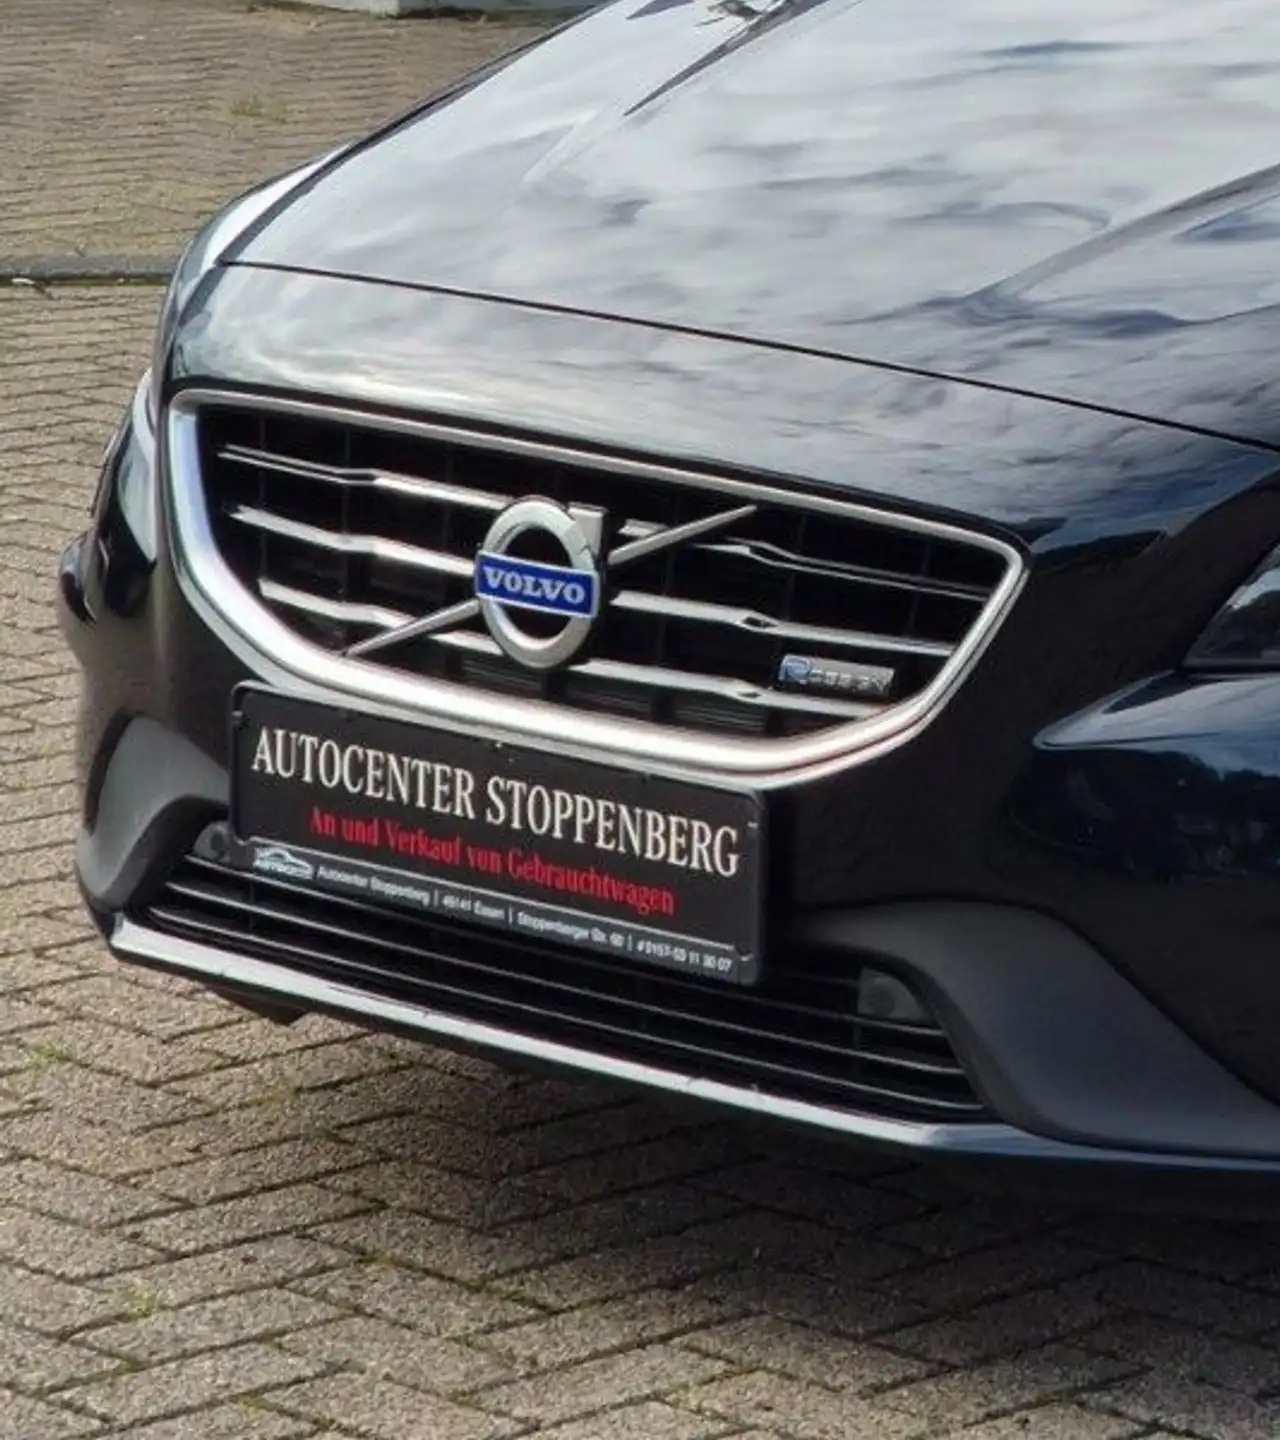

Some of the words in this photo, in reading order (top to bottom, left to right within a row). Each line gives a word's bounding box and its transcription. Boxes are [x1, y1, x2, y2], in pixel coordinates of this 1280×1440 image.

[482, 565, 586, 605] VOLVO
[250, 725, 476, 820] AUTOCENTER
[485, 776, 739, 878] STOPPENBERG
[309, 805, 337, 837] An
[340, 811, 380, 848] und
[385, 816, 462, 864] Verkauf
[466, 841, 503, 874] von
[507, 849, 677, 917] Gebrauchtwagen
